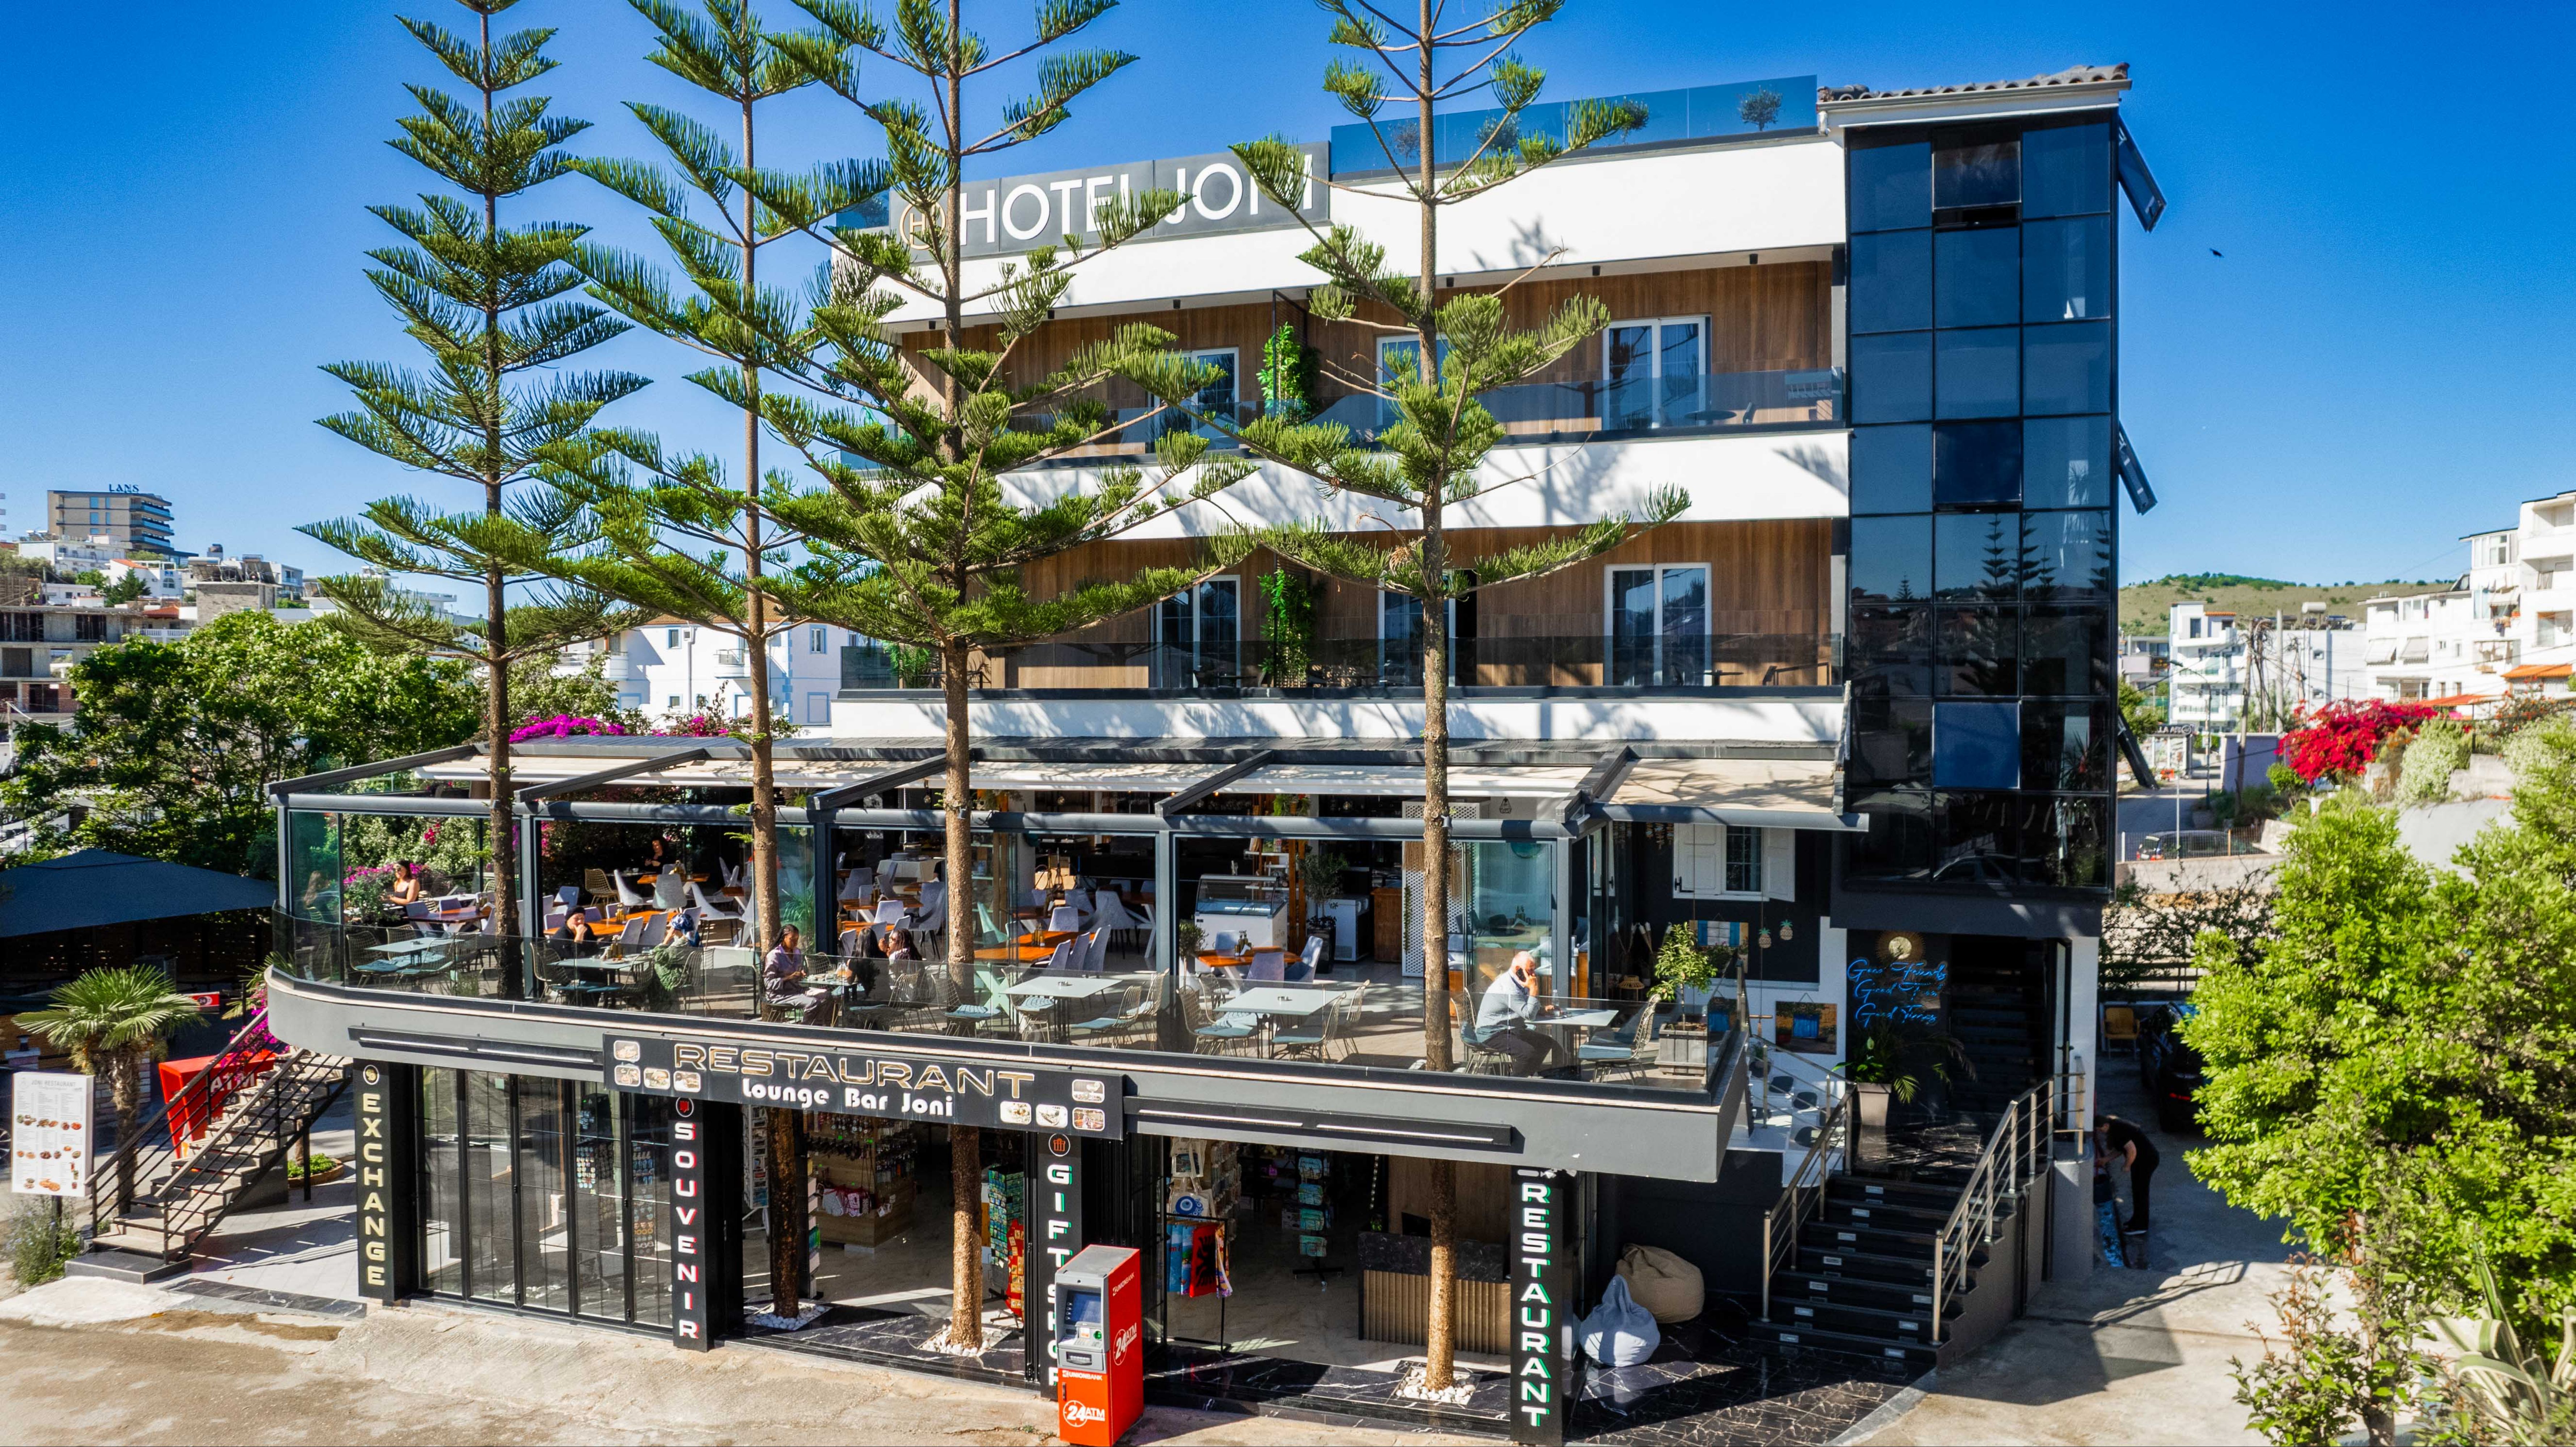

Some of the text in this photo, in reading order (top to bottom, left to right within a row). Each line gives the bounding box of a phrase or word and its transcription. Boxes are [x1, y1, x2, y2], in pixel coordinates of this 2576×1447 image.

[960, 174, 1145, 246] HOTEL
[1855, 979, 1898, 1003] Good
[1856, 1002, 1898, 1027] Good
[674, 1043, 1035, 1099] RESTAURANT
[743, 1078, 952, 1116] Lounge Bar Joni
[363, 1093, 385, 1286] EXCHANGE
[674, 1122, 699, 1339] SOUVENIR
[1047, 1164, 1073, 1268] GIFT
[1520, 1183, 1551, 1427] RESTAURANT
[1115, 1323, 1137, 1360] 24 ATM
[1069, 1372, 1103, 1381] UNIONBANK
[1067, 1405, 1105, 1422] 24 ATM
